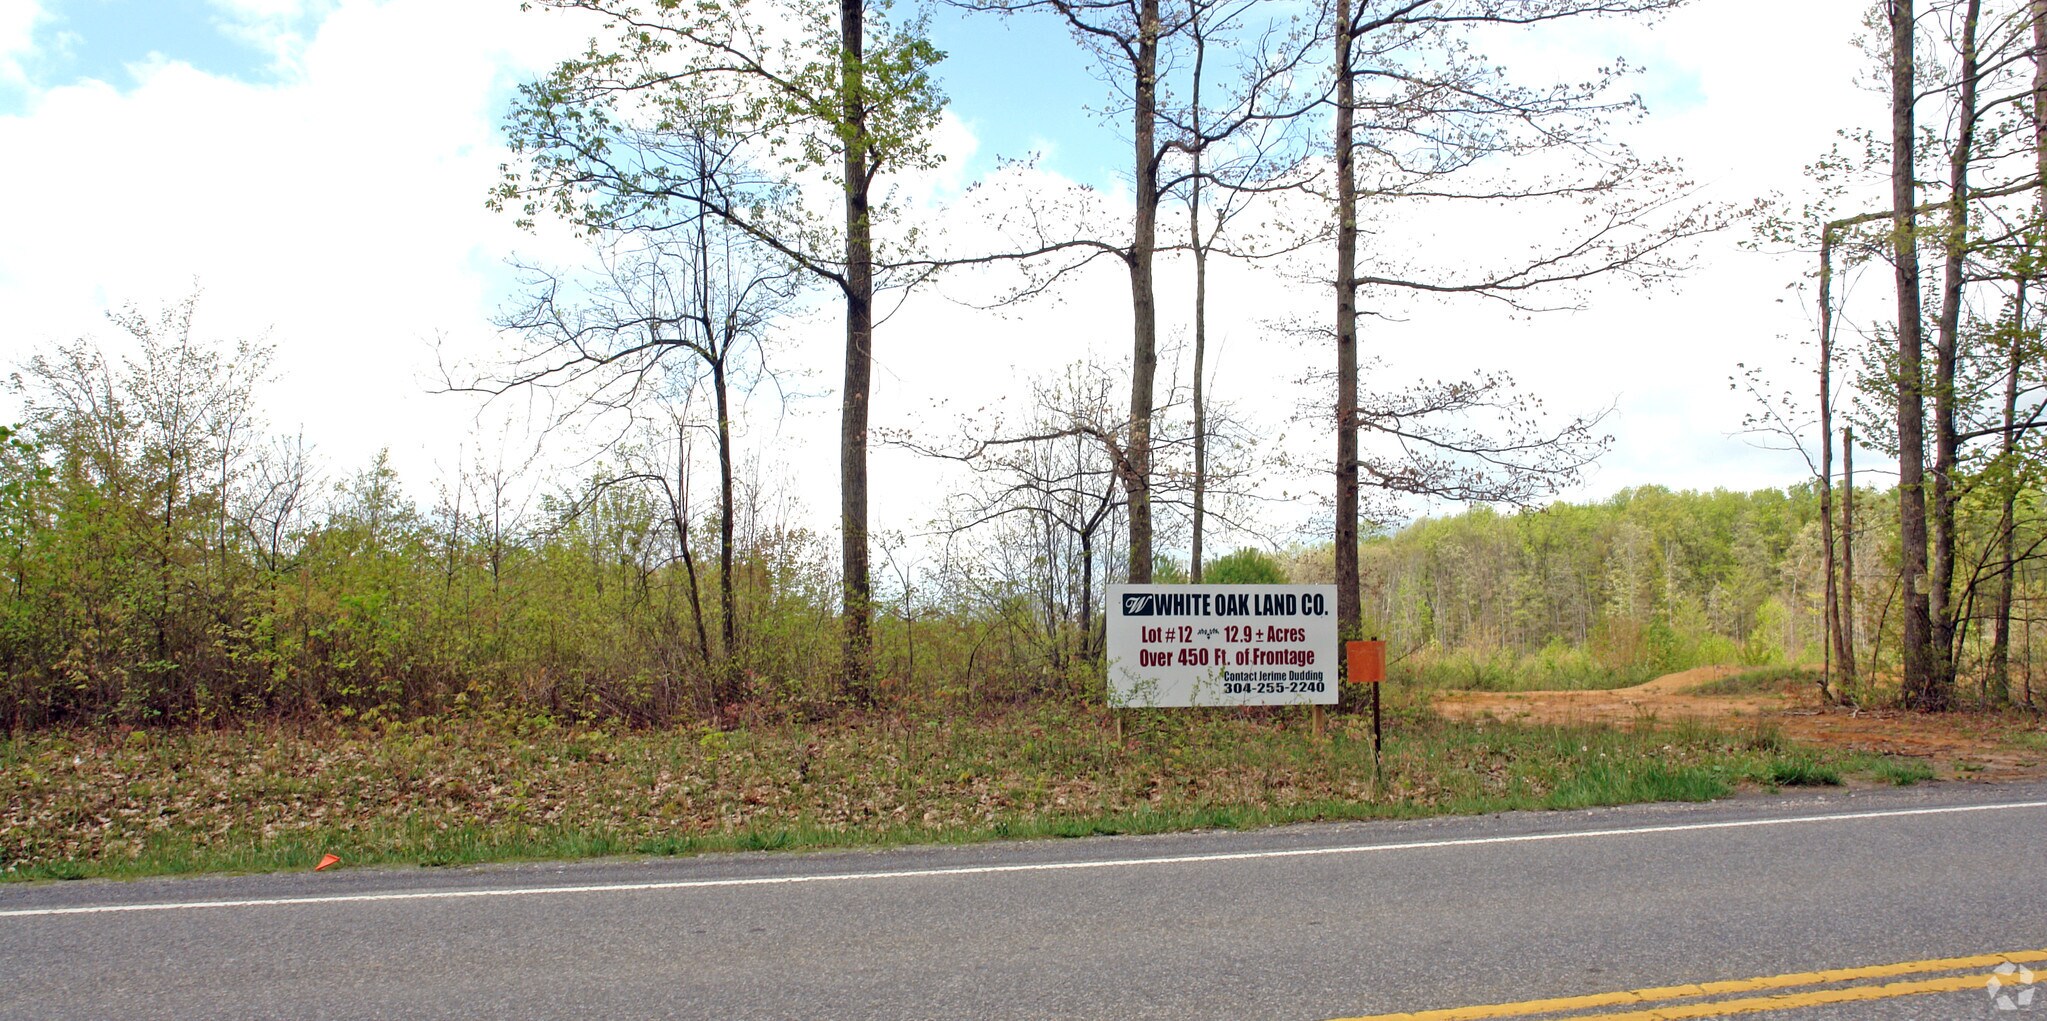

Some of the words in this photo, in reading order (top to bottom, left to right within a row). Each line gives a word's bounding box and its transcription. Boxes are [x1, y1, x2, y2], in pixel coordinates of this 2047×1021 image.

[1153, 594, 1211, 616] WHITE
[1215, 594, 1249, 616] OAK
[1255, 593, 1297, 616] LAND
[1301, 593, 1328, 615] CO.
[1142, 626, 1162, 643] Lot
[1224, 626, 1251, 642] 12.9
[1267, 626, 1305, 642] Acres
[1140, 650, 1173, 667] Over
[1178, 649, 1208, 666] 450
[1215, 649, 1231, 666] Ft.
[1236, 648, 1251, 665] of
[1253, 648, 1315, 666] Frontage
[1224, 671, 1257, 681] Contact
[1259, 671, 1286, 681] Jerime
[1289, 671, 1323, 682] Dudding
[1224, 681, 1325, 693] 304-255-2240
